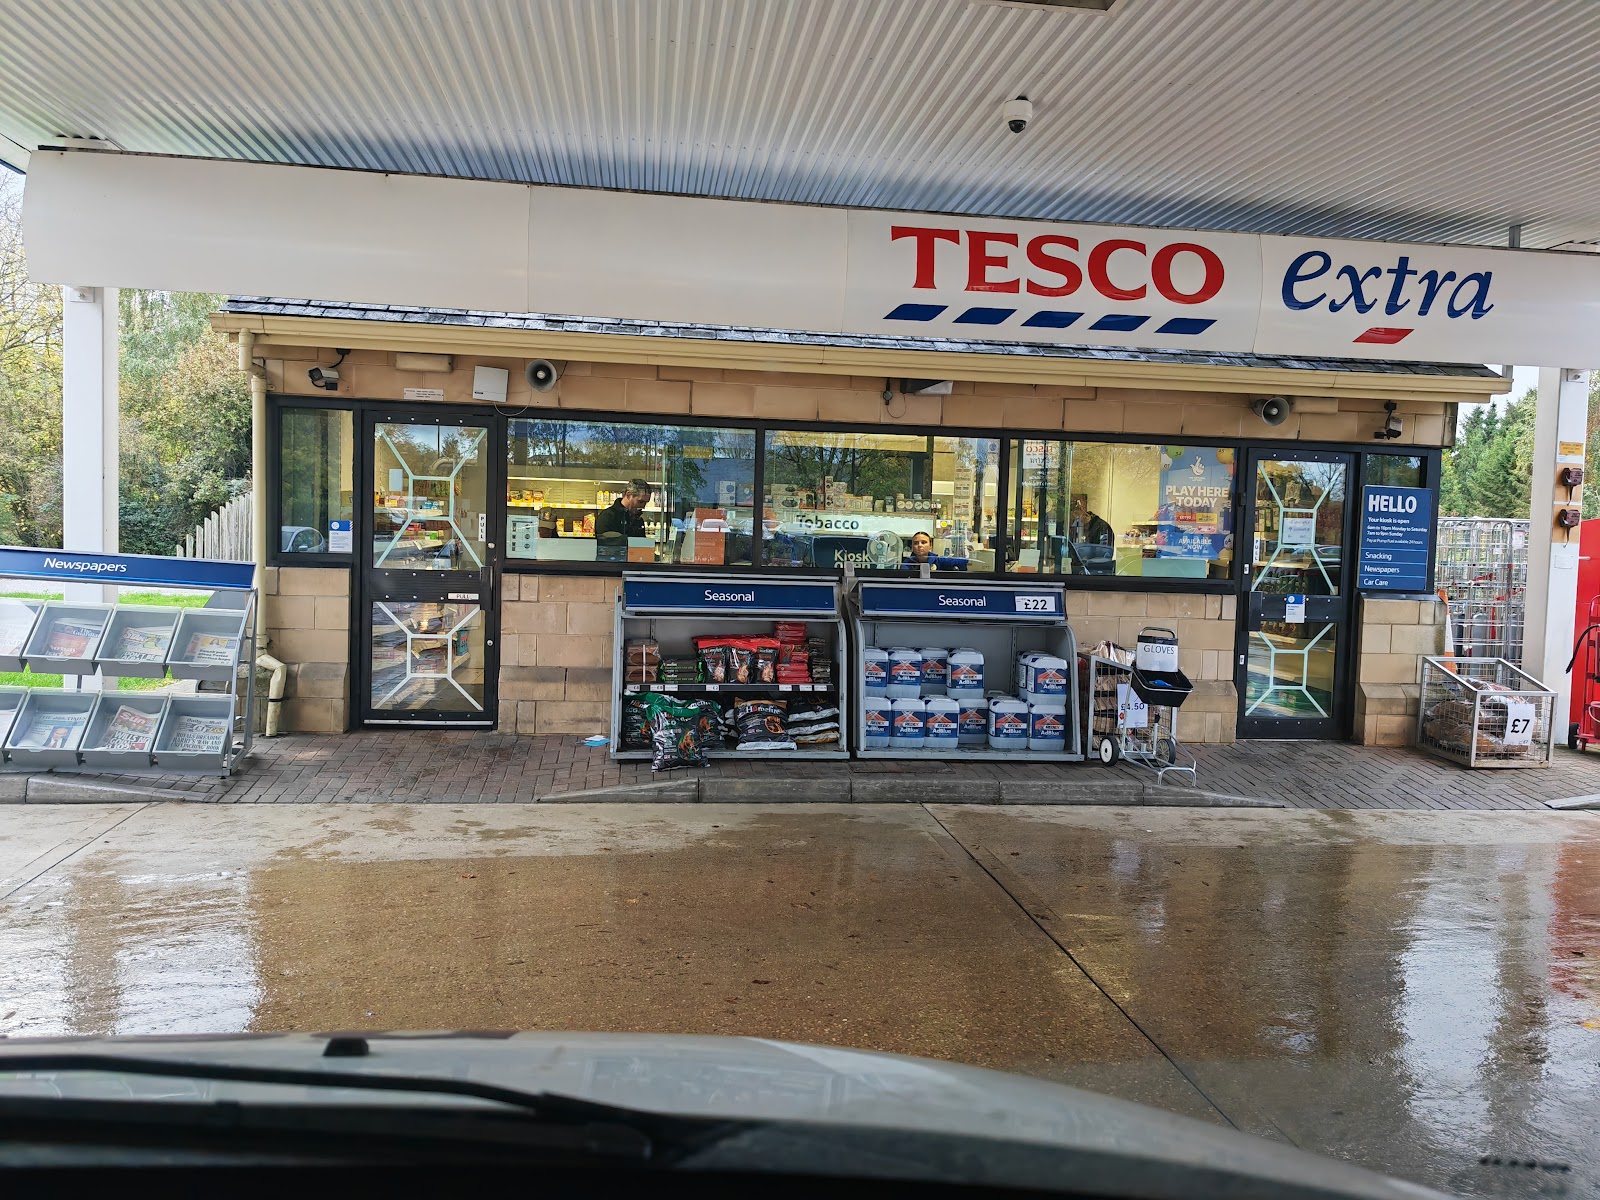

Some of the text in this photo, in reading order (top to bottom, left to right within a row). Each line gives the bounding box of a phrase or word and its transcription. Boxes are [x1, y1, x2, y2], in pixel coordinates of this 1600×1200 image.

[890, 224, 1495, 320] TESCO extra
[1166, 485, 1229, 498] PLAY HERE
[1175, 497, 1218, 508] TODAY
[1368, 494, 1417, 514] HELLO
[796, 514, 859, 530] Tobacco
[834, 549, 870, 561] Kiosk
[1365, 552, 1392, 561] Snacking
[43, 557, 128, 573] Newspapers
[1364, 565, 1400, 574] Newspapers
[704, 589, 754, 602] Seasonal
[938, 595, 987, 607] Seasonal
[1024, 599, 1048, 610] £22
[1143, 645, 1175, 655] GLOVES
[119, 710, 147, 724] Sun
[1510, 718, 1530, 734] £7
[114, 731, 138, 742] WILLS
